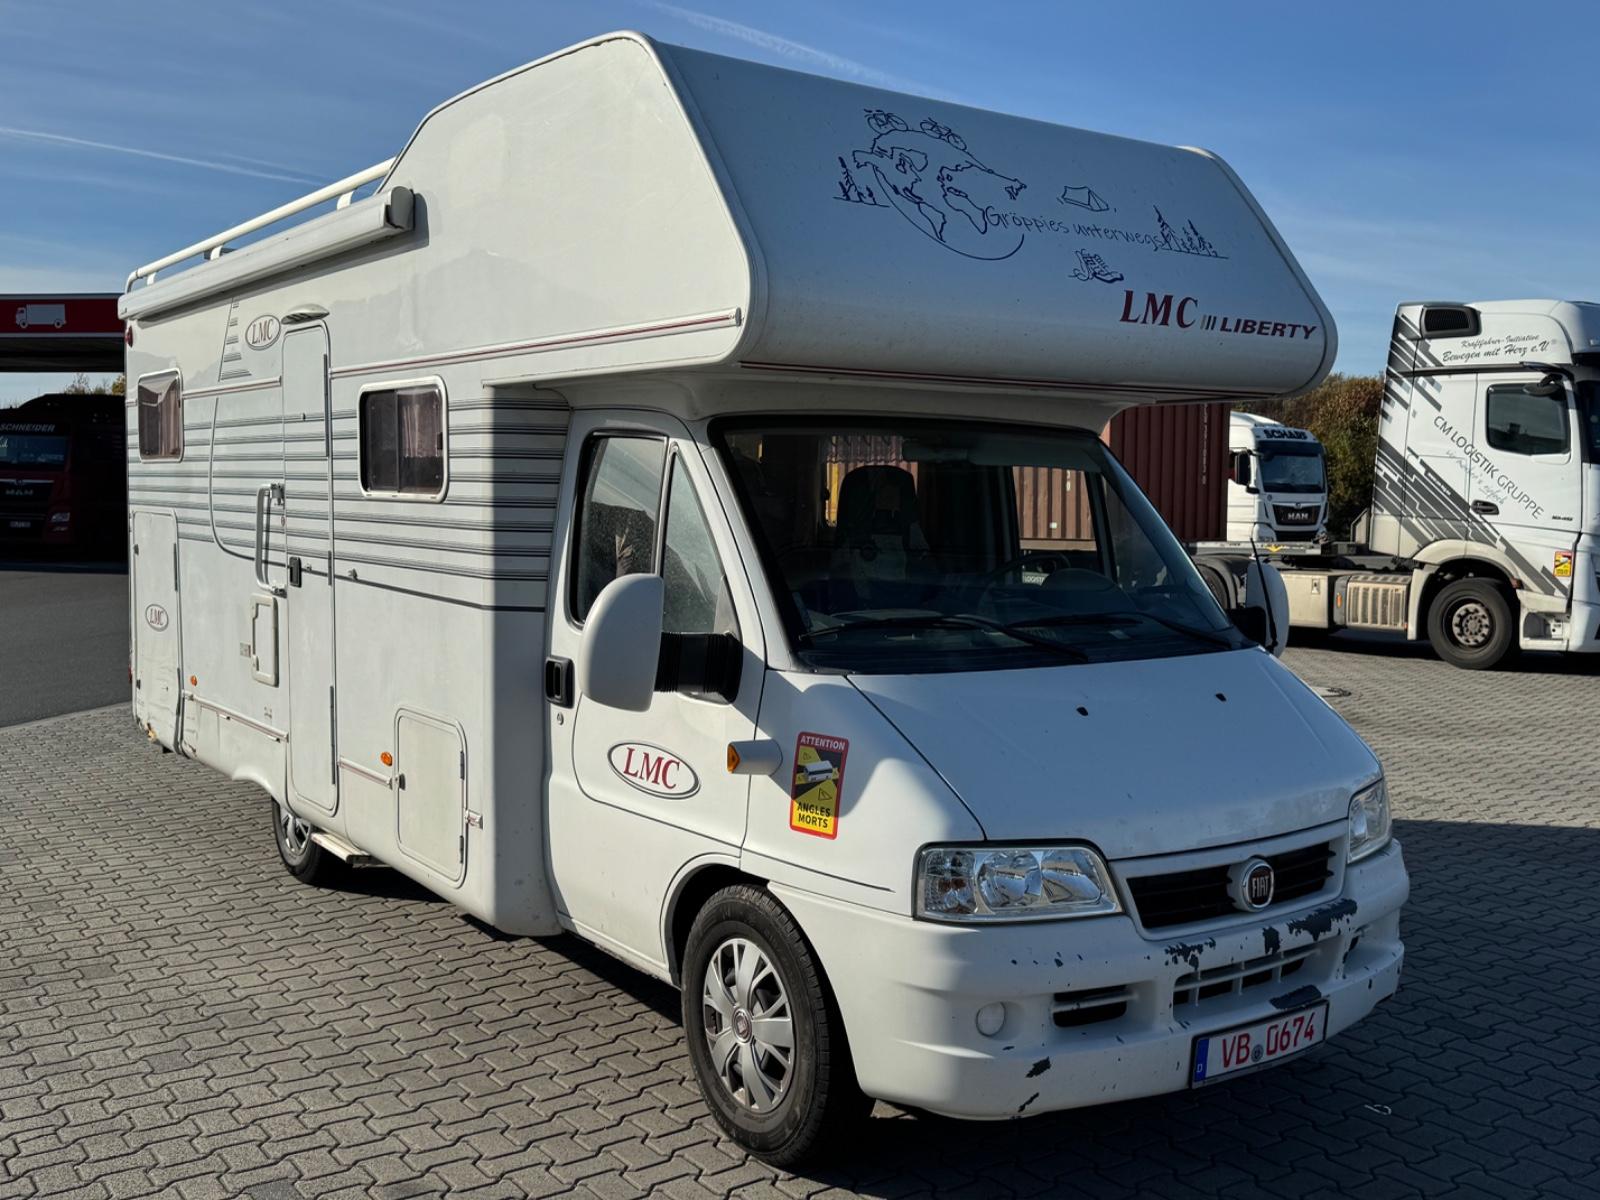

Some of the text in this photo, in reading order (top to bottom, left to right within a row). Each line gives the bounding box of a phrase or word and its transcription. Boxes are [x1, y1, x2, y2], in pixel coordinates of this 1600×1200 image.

[985, 205, 1163, 251] Gröppies unterwegs
[1119, 290, 1316, 339] LMC LIBERTY
[252, 318, 274, 344] LMC
[1443, 350, 1480, 363] Bewegen
[1483, 348, 1501, 357] mit
[1504, 343, 1528, 357] Herz
[0, 423, 56, 432] SCHNEIDER
[1433, 415, 1453, 436] CM
[1450, 431, 1499, 479] LOGISTIK
[1497, 474, 1544, 520] GRUPPE
[1287, 512, 1309, 520] MAN
[150, 608, 165, 626] LMC
[800, 735, 846, 750] ATTENTION
[623, 747, 681, 790] LMC
[797, 801, 831, 817] ANGLES
[798, 813, 828, 828] MORTS
[1252, 875, 1270, 898] FIAT
[1221, 1032, 1251, 1068] VB
[1196, 1063, 1203, 1073] D
